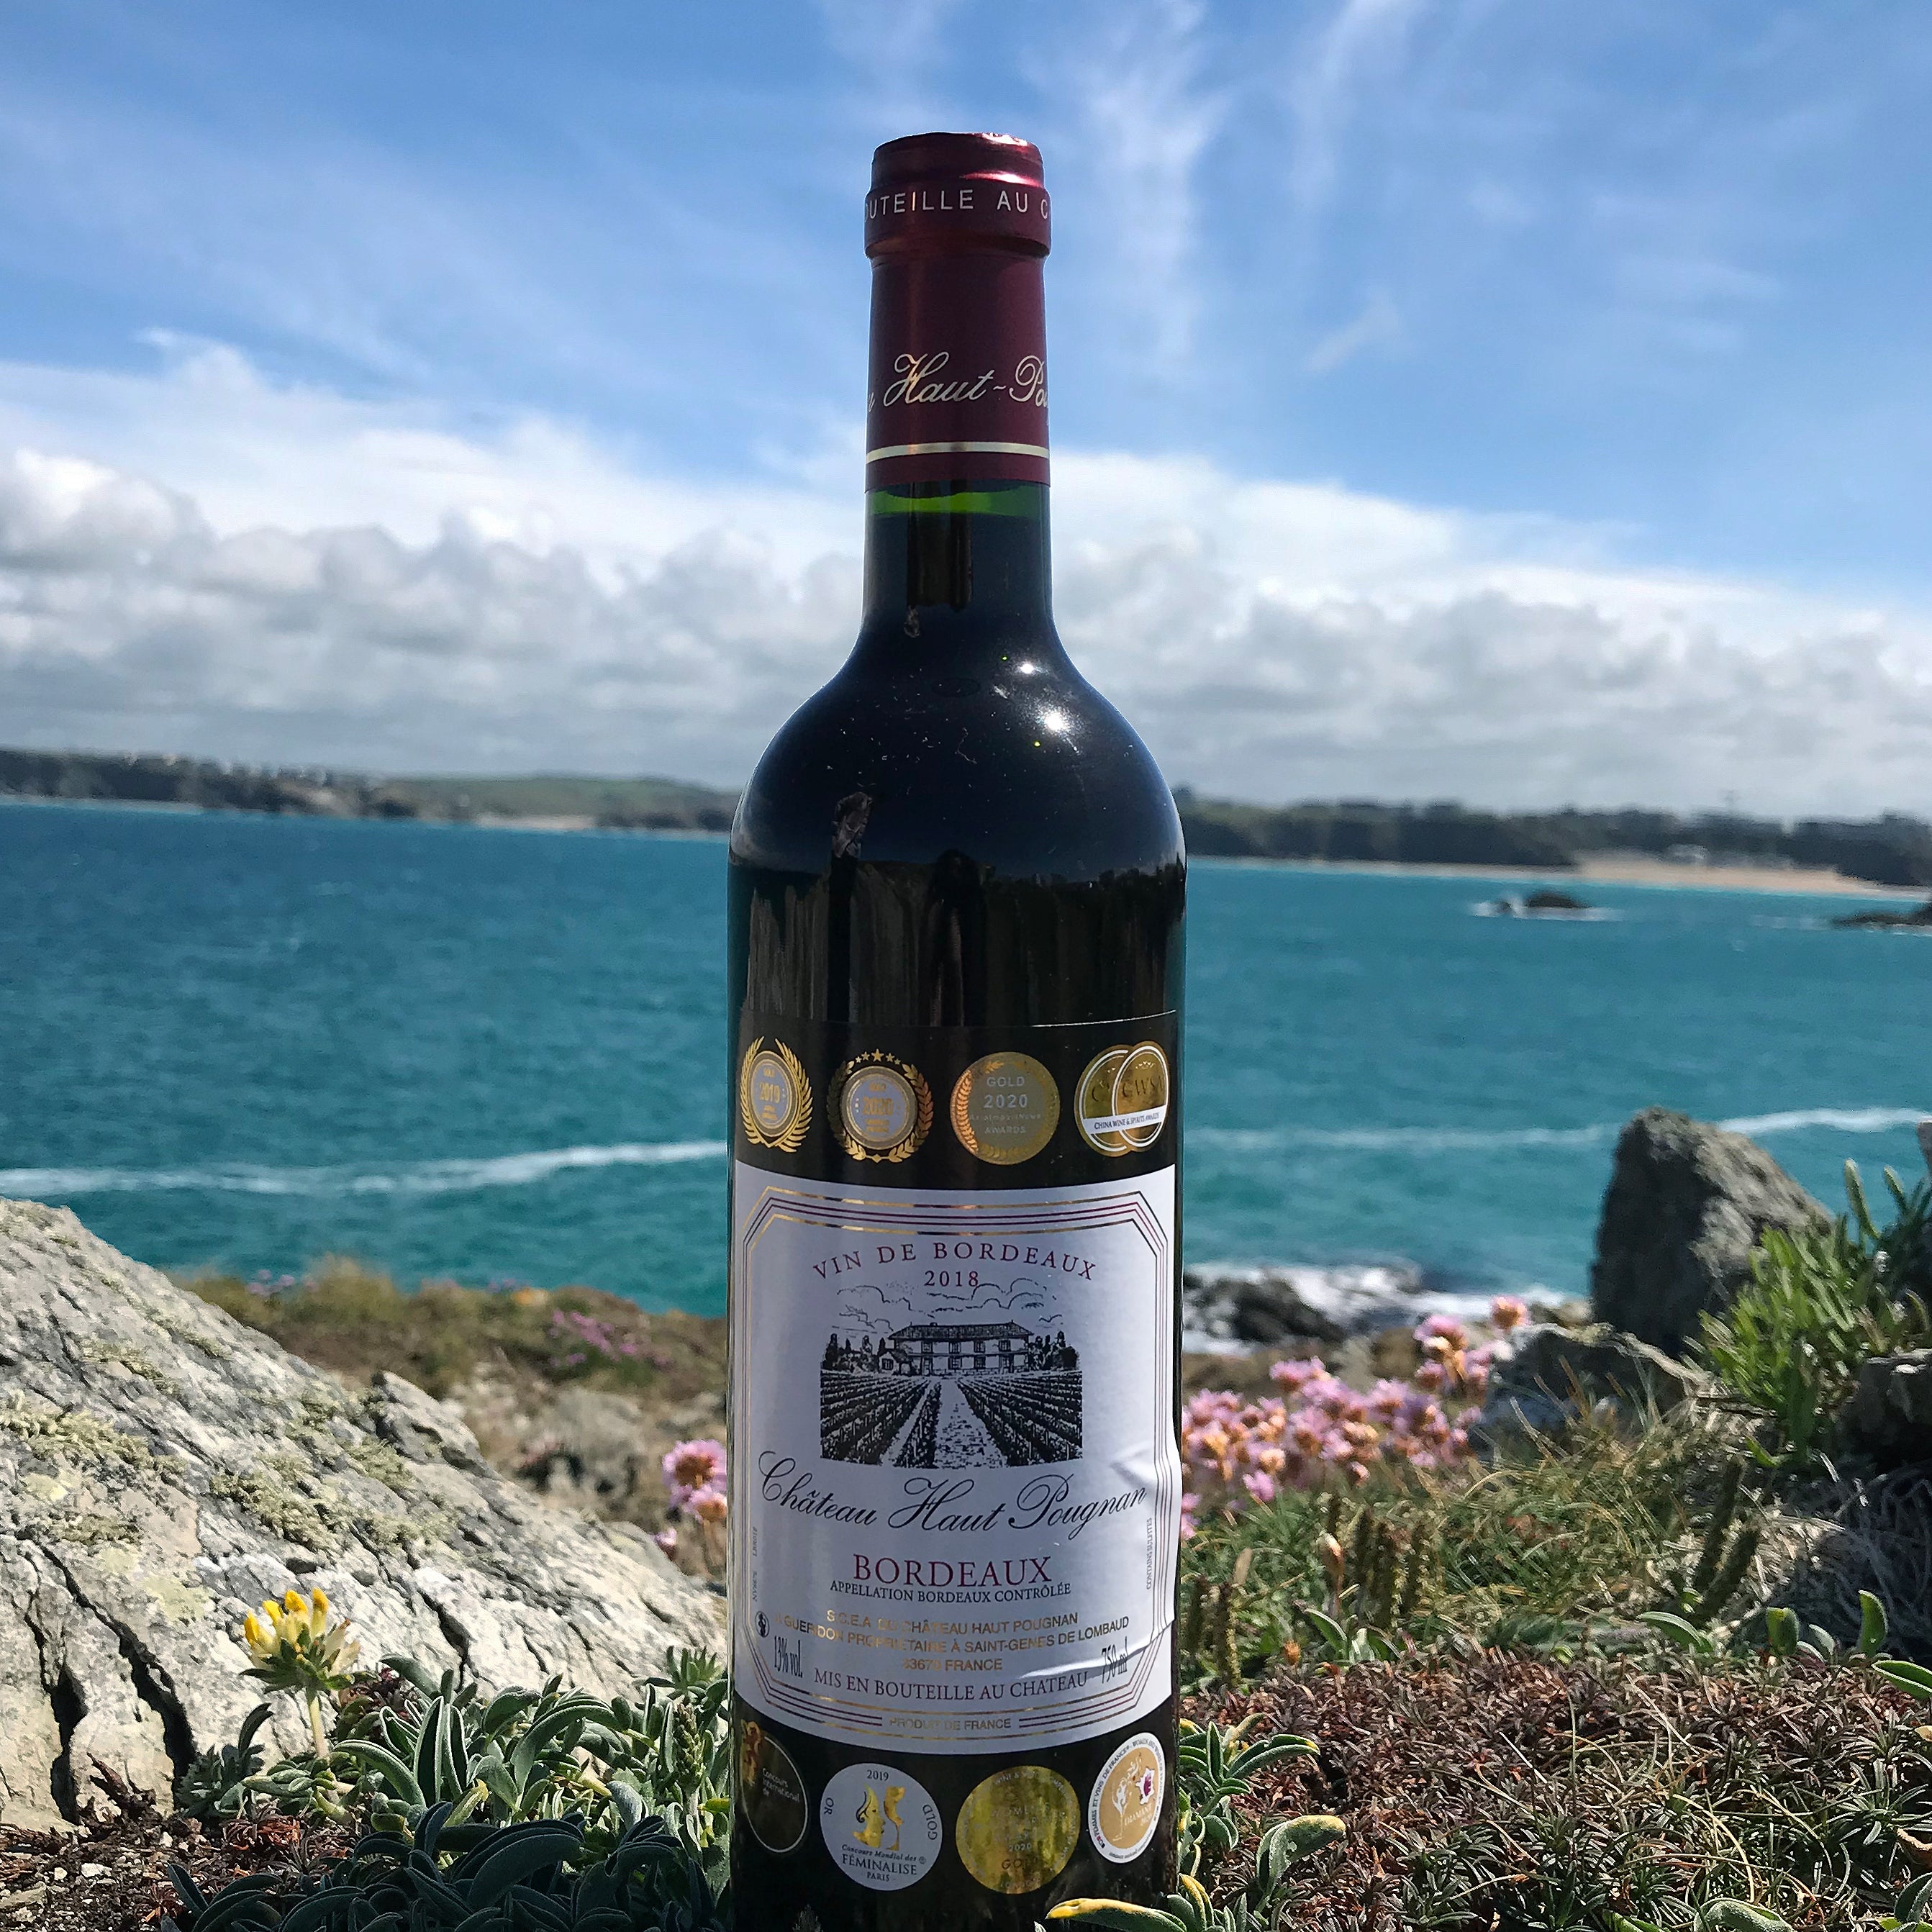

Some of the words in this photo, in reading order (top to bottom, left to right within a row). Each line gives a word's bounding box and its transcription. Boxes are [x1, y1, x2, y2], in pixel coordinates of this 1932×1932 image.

[865, 189, 974, 222] UTEILLE
[997, 190, 1028, 213] AU
[987, 1076, 1025, 1087] GOLD
[984, 1094, 1028, 1108] 2020
[984, 1125, 1027, 1135] AWARDS
[1094, 1120, 1112, 1130] CHINA
[1112, 1118, 1125, 1127] WINE
[812, 1251, 862, 1280] VIN
[876, 1243, 917, 1264] DE
[935, 1242, 1097, 1281] BORDEAUX
[924, 1270, 979, 1287] 2018
[758, 1450, 877, 1526] Château
[888, 1477, 1007, 1531] Haut
[1008, 1473, 1148, 1541] Pougnan
[853, 1554, 1053, 1587] BORDEAUX
[830, 1580, 913, 1602] APPELLATION
[917, 1590, 992, 1603] BORDEAUX
[994, 1582, 1071, 1602] CONTRÔLÉE
[784, 1615, 843, 1643] GUERIDON
[951, 1638, 960, 1653] À
[964, 1634, 1055, 1653] SAINT-GENES
[1058, 1632, 1075, 1645] DE
[1079, 1615, 1130, 1641] LOMBAUD
[878, 1618, 898, 1631] DU
[902, 1620, 968, 1636] CHÂTEAU
[972, 1621, 1010, 1635] HAUT
[1013, 1613, 1079, 1632] POUGNAN
[774, 1636, 789, 1673] 13%
[790, 1639, 803, 1679] vol.
[945, 1658, 1003, 1672] FRANCE
[1102, 1644, 1117, 1684] 750
[814, 1667, 842, 1689] MIS
[847, 1675, 869, 1694] EN
[875, 1679, 975, 1700] BOUTEILLE
[979, 1684, 1004, 1700] AU
[1010, 1671, 1089, 1697] CHATEAU
[889, 1717, 940, 1729] PRODUIT
[944, 1720, 961, 1731] DE
[964, 1718, 1011, 1730] FRANCE
[763, 1767, 789, 1788] Concours
[866, 1769, 889, 1781] 2019
[1094, 1780, 1105, 1797] VINS
[1102, 1768, 1110, 1779] DE
[763, 1777, 799, 1803] International
[823, 1797, 834, 1815] OR
[922, 1804, 938, 1841] GOLD
[841, 1844, 873, 1856] Concours
[875, 1851, 903, 1860] Mondial
[1008, 1842, 1032, 1854] 2020
[842, 1854, 917, 1875] FÉMINALISE
[866, 1872, 890, 1882] PARIS
